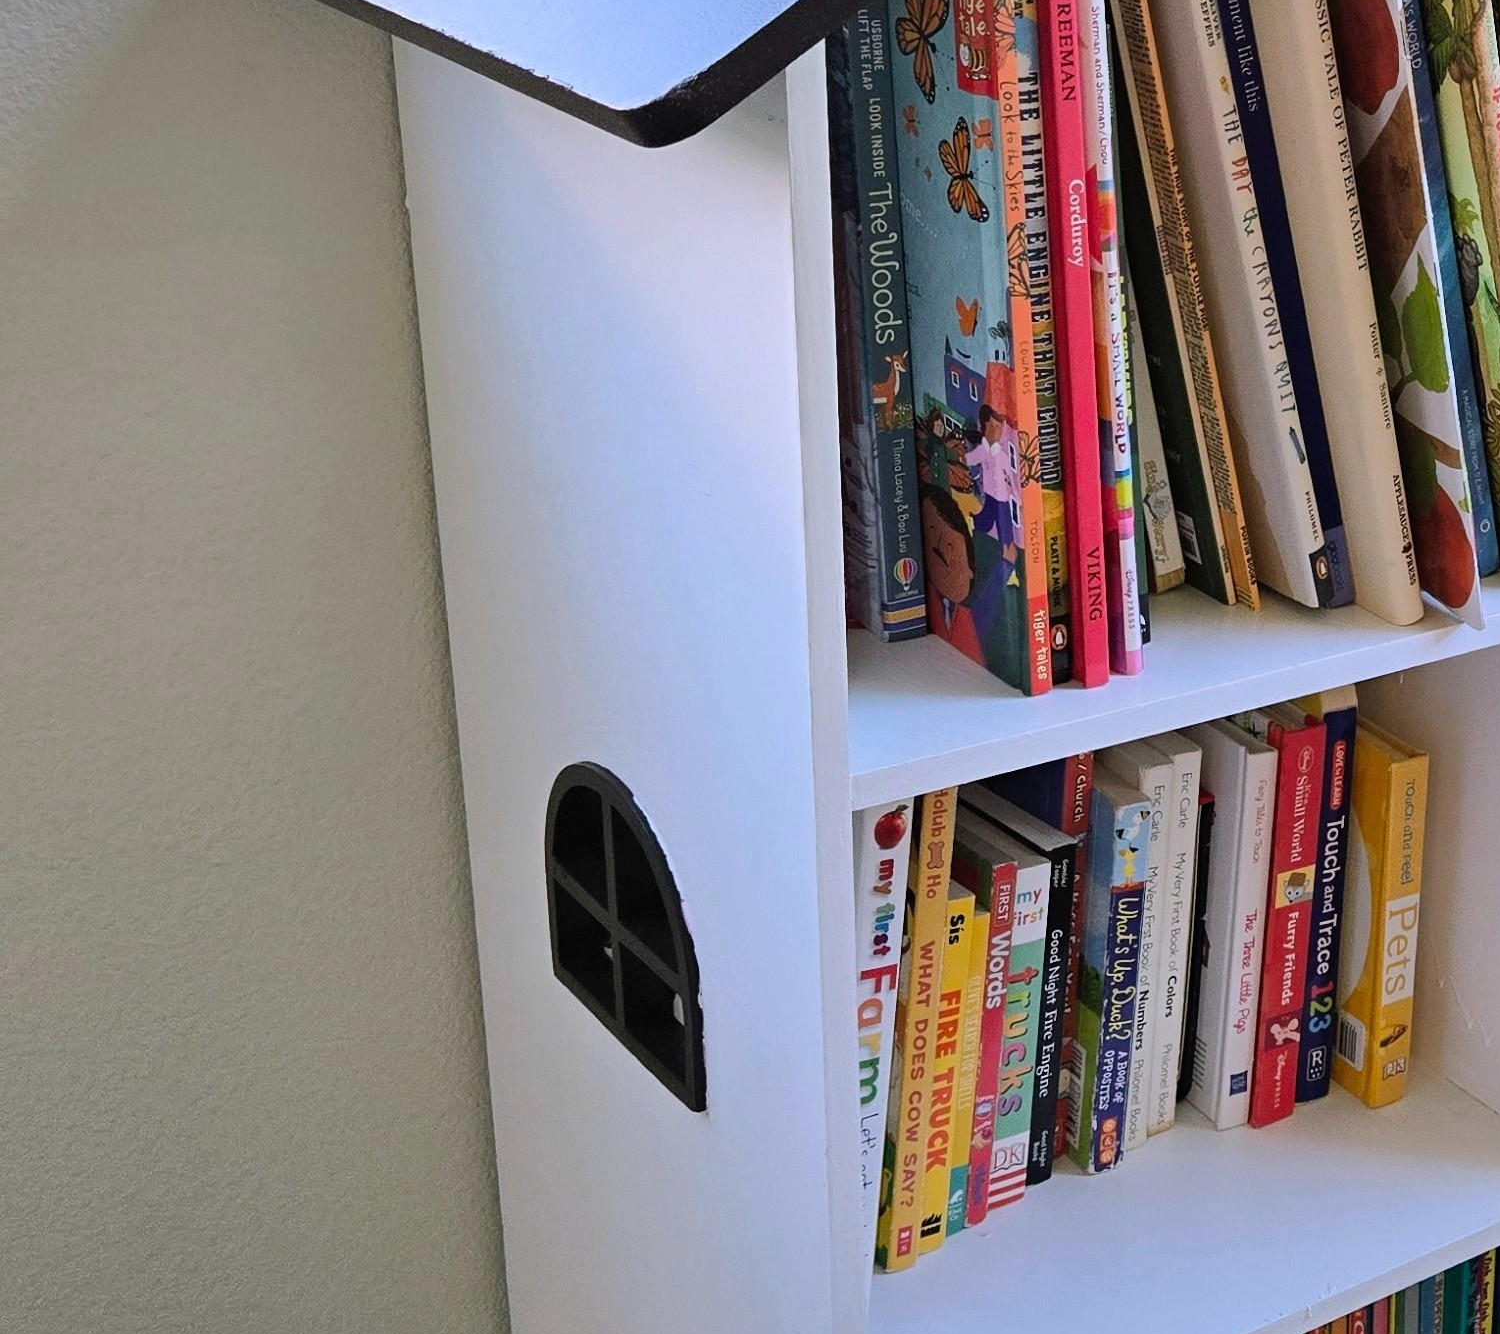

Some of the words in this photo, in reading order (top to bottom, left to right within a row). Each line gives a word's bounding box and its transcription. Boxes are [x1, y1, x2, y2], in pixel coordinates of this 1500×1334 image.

[857, 9, 868, 36] LIFT
[871, 20, 885, 71] USBORNE
[1406, 19, 1424, 70] WORLD
[859, 37, 870, 59] THE
[1237, 45, 1253, 77] like
[861, 59, 874, 91] FLAP
[1018, 71, 1040, 122] THE
[1242, 75, 1259, 114] this
[1322, 48, 1340, 100] TALE
[869, 97, 883, 132] LOOK
[999, 81, 1015, 124] Look
[1222, 104, 1243, 145] THE
[1332, 105, 1346, 129] OF
[871, 133, 886, 178] INSIDE
[1005, 131, 1014, 143] to
[1006, 144, 1014, 169] the
[1006, 169, 1023, 213] Skies
[1021, 132, 1046, 220] LITTLE
[1231, 156, 1253, 194] DAY
[1337, 137, 1358, 202] PETER
[1067, 178, 1088, 267] Corduroy
[1243, 206, 1260, 237] the
[1348, 204, 1370, 272] RABBIT
[1027, 231, 1052, 324] ENGINE
[1251, 245, 1283, 350] CRAYONS
[1018, 341, 1031, 395] EDWARDS
[1032, 330, 1057, 401] THAT
[1274, 360, 1297, 413] QUIT
[1036, 405, 1061, 486] COULD
[1304, 491, 1320, 542] PHILOMEL
[1392, 474, 1409, 544] APPLESAUCE
[1405, 553, 1418, 586] PRESS
[1030, 521, 1040, 564] TOLSON
[1086, 546, 1103, 622] VIKING
[1033, 609, 1047, 644] tiger
[1127, 599, 1136, 630] PRESS
[1036, 645, 1049, 681] tales
[1073, 774, 1087, 823] Church
[1154, 784, 1165, 808] Eric
[1180, 772, 1192, 795] Eric
[1293, 774, 1309, 817] Small
[930, 789, 950, 838] Holub
[1150, 810, 1164, 843] Carle
[1178, 797, 1191, 829] Carle
[1290, 818, 1306, 864] World
[1324, 815, 1346, 883] Touch
[872, 858, 895, 896] my
[926, 873, 942, 900] Ho
[1017, 888, 1042, 904] my
[1321, 885, 1336, 914] and
[997, 884, 1011, 921] FIRST
[1114, 897, 1139, 955] What's
[872, 902, 895, 957] first
[1050, 929, 1064, 964] Good
[1283, 911, 1301, 951] Furry
[1317, 913, 1339, 976] Trace
[1384, 903, 1419, 997] Pets
[915, 940, 935, 1008] WHAT
[986, 930, 1012, 1009] Words
[1044, 964, 1061, 1005] Night
[1106, 958, 1135, 986] Up,
[1281, 952, 1297, 1006] Friends
[857, 963, 899, 1106] Farm
[934, 989, 962, 1060] FIRE
[1043, 1008, 1058, 1042] Fire
[1105, 986, 1137, 1041] Duck?
[910, 1018, 929, 1081] DOES
[998, 965, 1040, 1117] trucks
[1036, 1043, 1055, 1098] Engine
[1098, 1049, 1116, 1111] OPPOSITES
[1131, 1059, 1144, 1106] Philomel
[1158, 1043, 1173, 1091] Philomel
[904, 1090, 922, 1142] COW
[925, 1066, 955, 1174] TRUCK
[1128, 1108, 1141, 1142] Books
[1156, 1092, 1170, 1125] Books
[900, 1153, 918, 1208] SAY?
